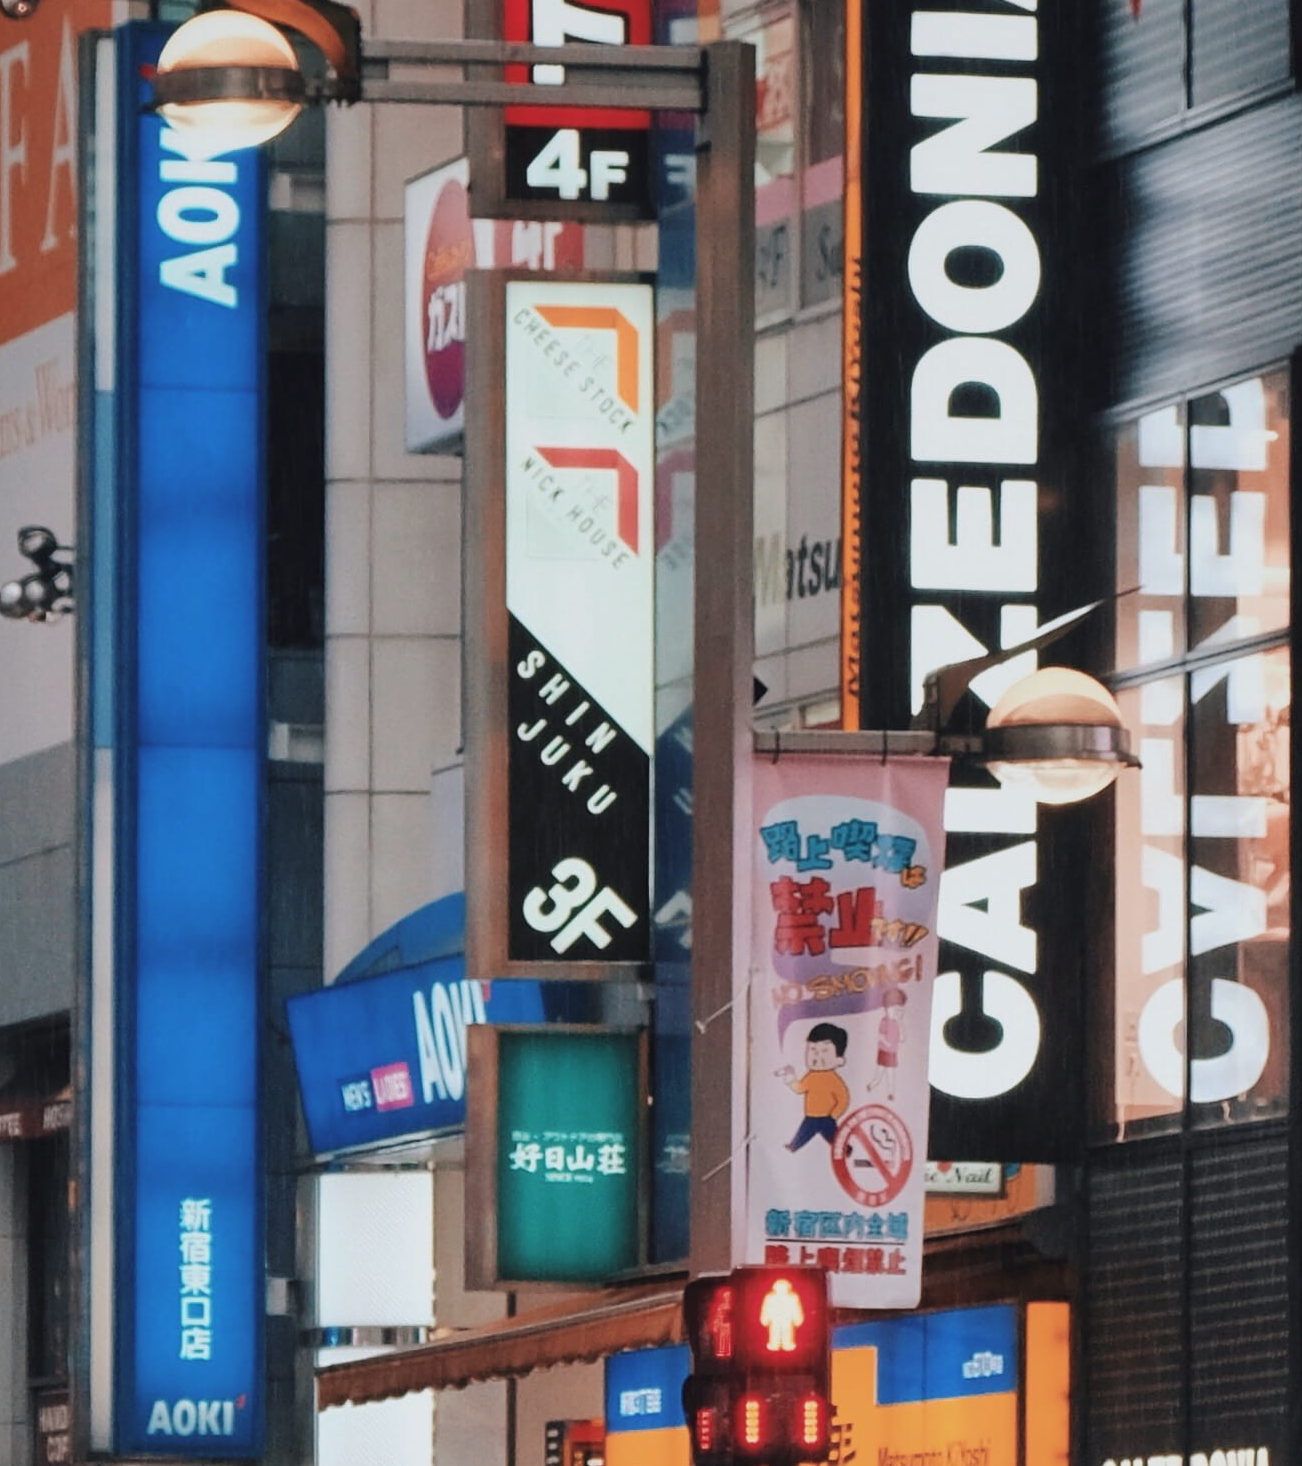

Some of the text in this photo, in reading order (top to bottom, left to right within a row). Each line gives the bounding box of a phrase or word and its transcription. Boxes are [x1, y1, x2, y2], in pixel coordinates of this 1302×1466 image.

[526, 128, 629, 200] 4F
[156, 124, 242, 310] AOK
[513, 308, 581, 378] CHEESE
[579, 375, 635, 434] STOCK
[566, 504, 631, 571] HOUSE
[517, 649, 618, 753] SHIN
[517, 716, 618, 815] JUKU
[523, 856, 639, 956] 3F
[413, 979, 486, 1104] AO
[509, 1143, 627, 1175] 好日山荘
[945, 1163, 995, 1186] Nail
[180, 1199, 212, 1362] 新宿東口店
[147, 1399, 235, 1437] AOKI
